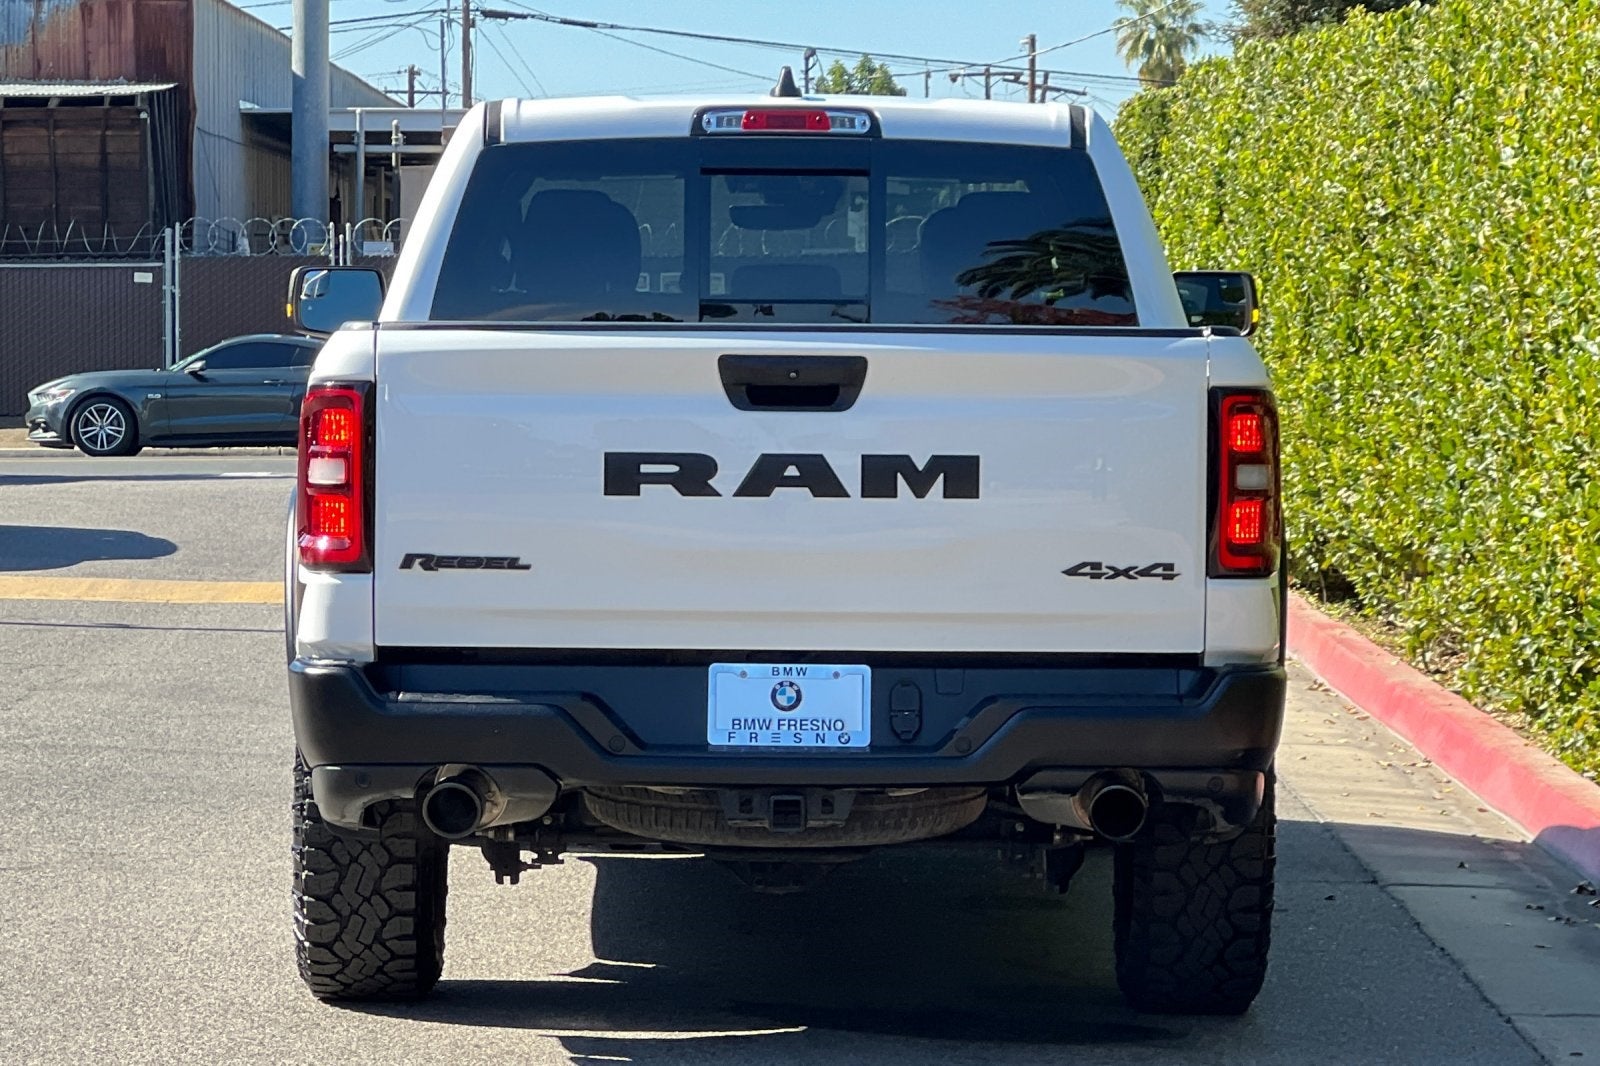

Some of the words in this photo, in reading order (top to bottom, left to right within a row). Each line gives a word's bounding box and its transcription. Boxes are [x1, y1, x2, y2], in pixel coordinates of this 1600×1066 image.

[604, 452, 980, 499] RAM
[399, 553, 531, 571] REBEL
[1061, 562, 1181, 580] 4x4
[771, 667, 807, 676] BMW
[731, 719, 772, 730] BMW
[777, 720, 845, 731] FRESNO
